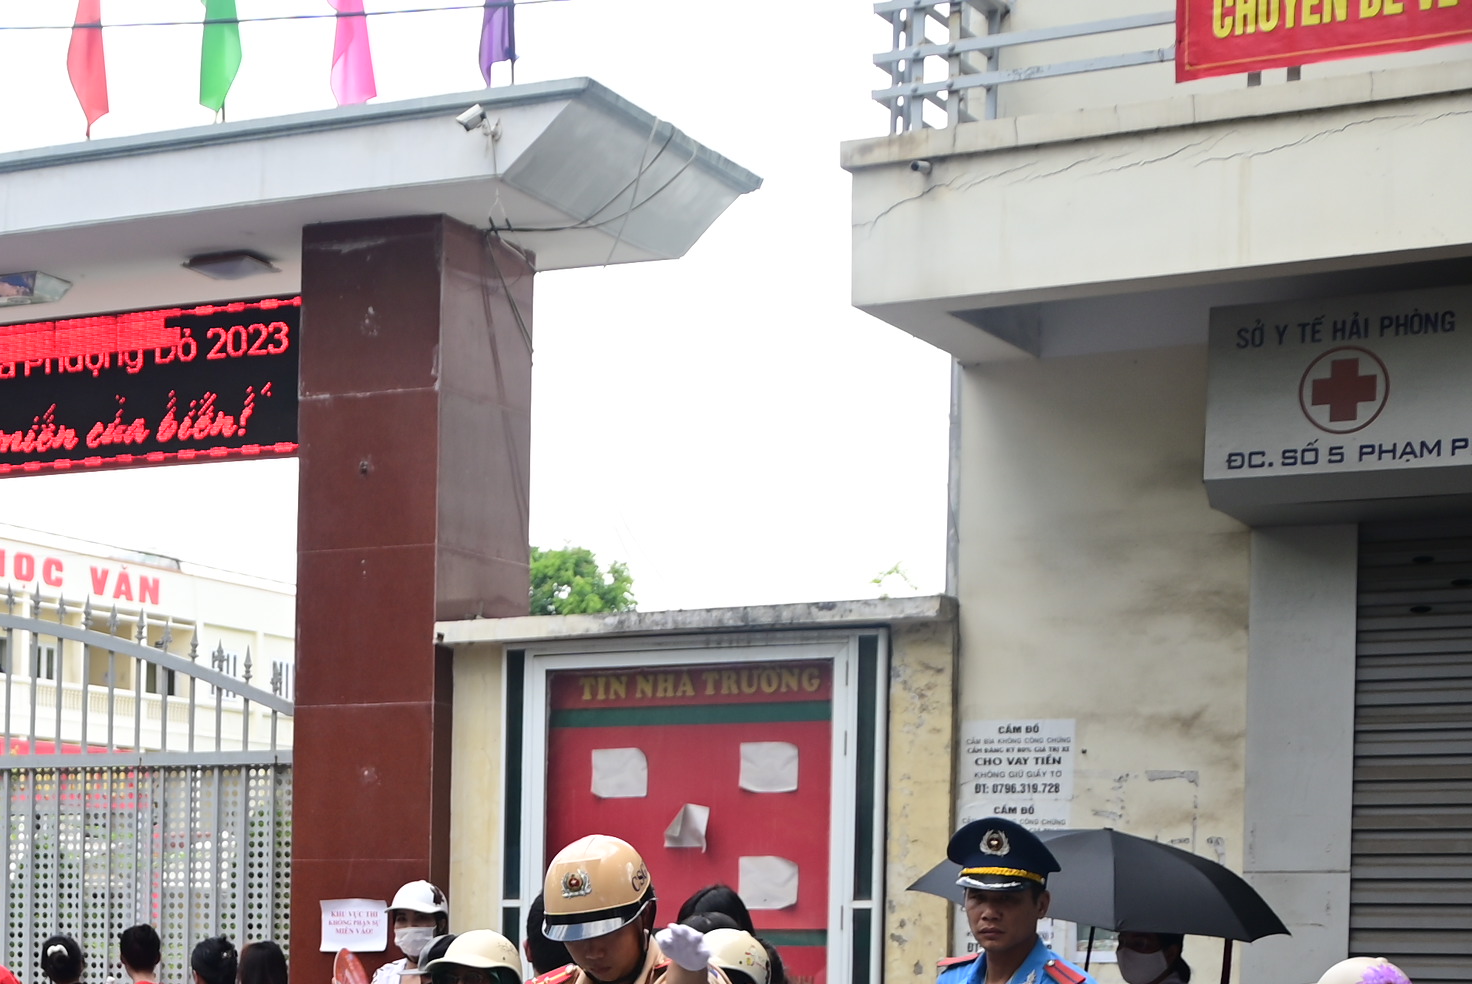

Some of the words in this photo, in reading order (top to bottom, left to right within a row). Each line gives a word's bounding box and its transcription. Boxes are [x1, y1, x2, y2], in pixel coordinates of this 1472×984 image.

[207, 321, 291, 360] 2023
[1236, 318, 1265, 349] SỞ
[1275, 324, 1289, 345] Y
[1297, 314, 1326, 344] TẾ
[1332, 312, 1370, 341] HẢI
[1379, 309, 1456, 338] PHÒNG
[1281, 438, 1320, 467] SỐ
[1327, 445, 1345, 464] 5
[1358, 438, 1443, 463] PHẠM
[90, 564, 162, 605] VĂN
[579, 676, 628, 700] TIN
[635, 670, 696, 698] NHÀ
[974, 757, 1003, 766] CHO
[1007, 756, 1030, 766] VAY
